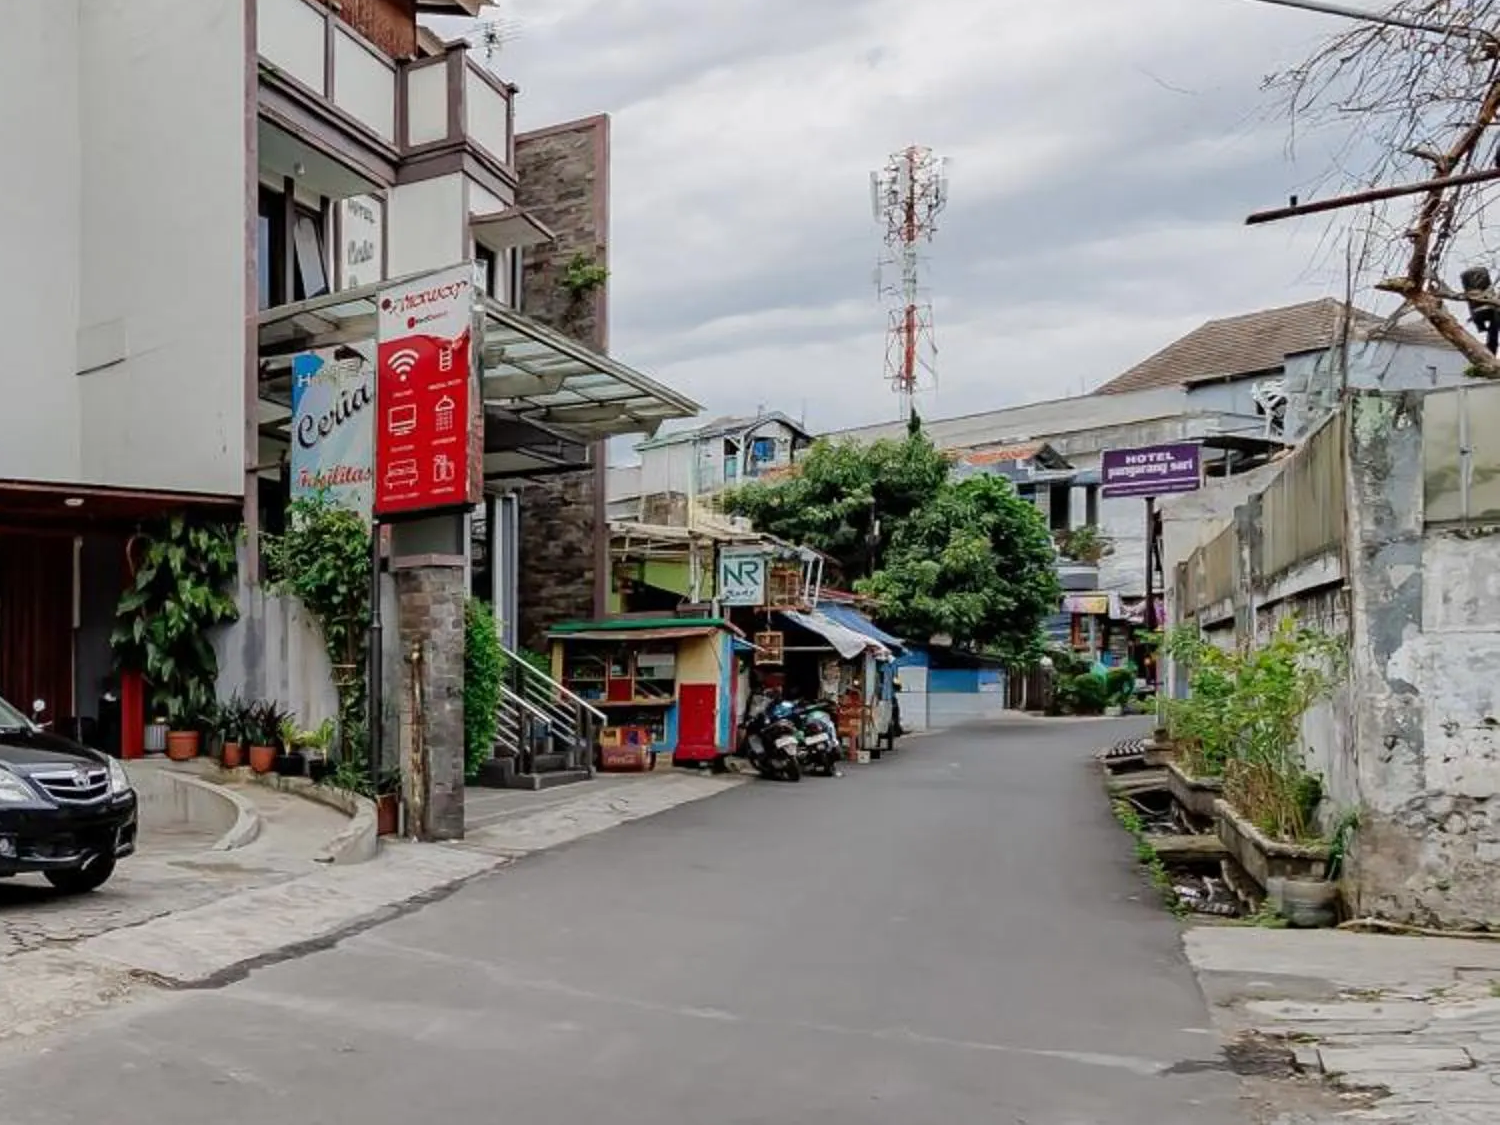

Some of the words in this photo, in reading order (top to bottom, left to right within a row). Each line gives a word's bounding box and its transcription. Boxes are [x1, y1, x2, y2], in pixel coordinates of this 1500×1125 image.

[298, 382, 372, 449] Ceria
[1125, 452, 1175, 465] HOTEL
[723, 560, 760, 587] NR
